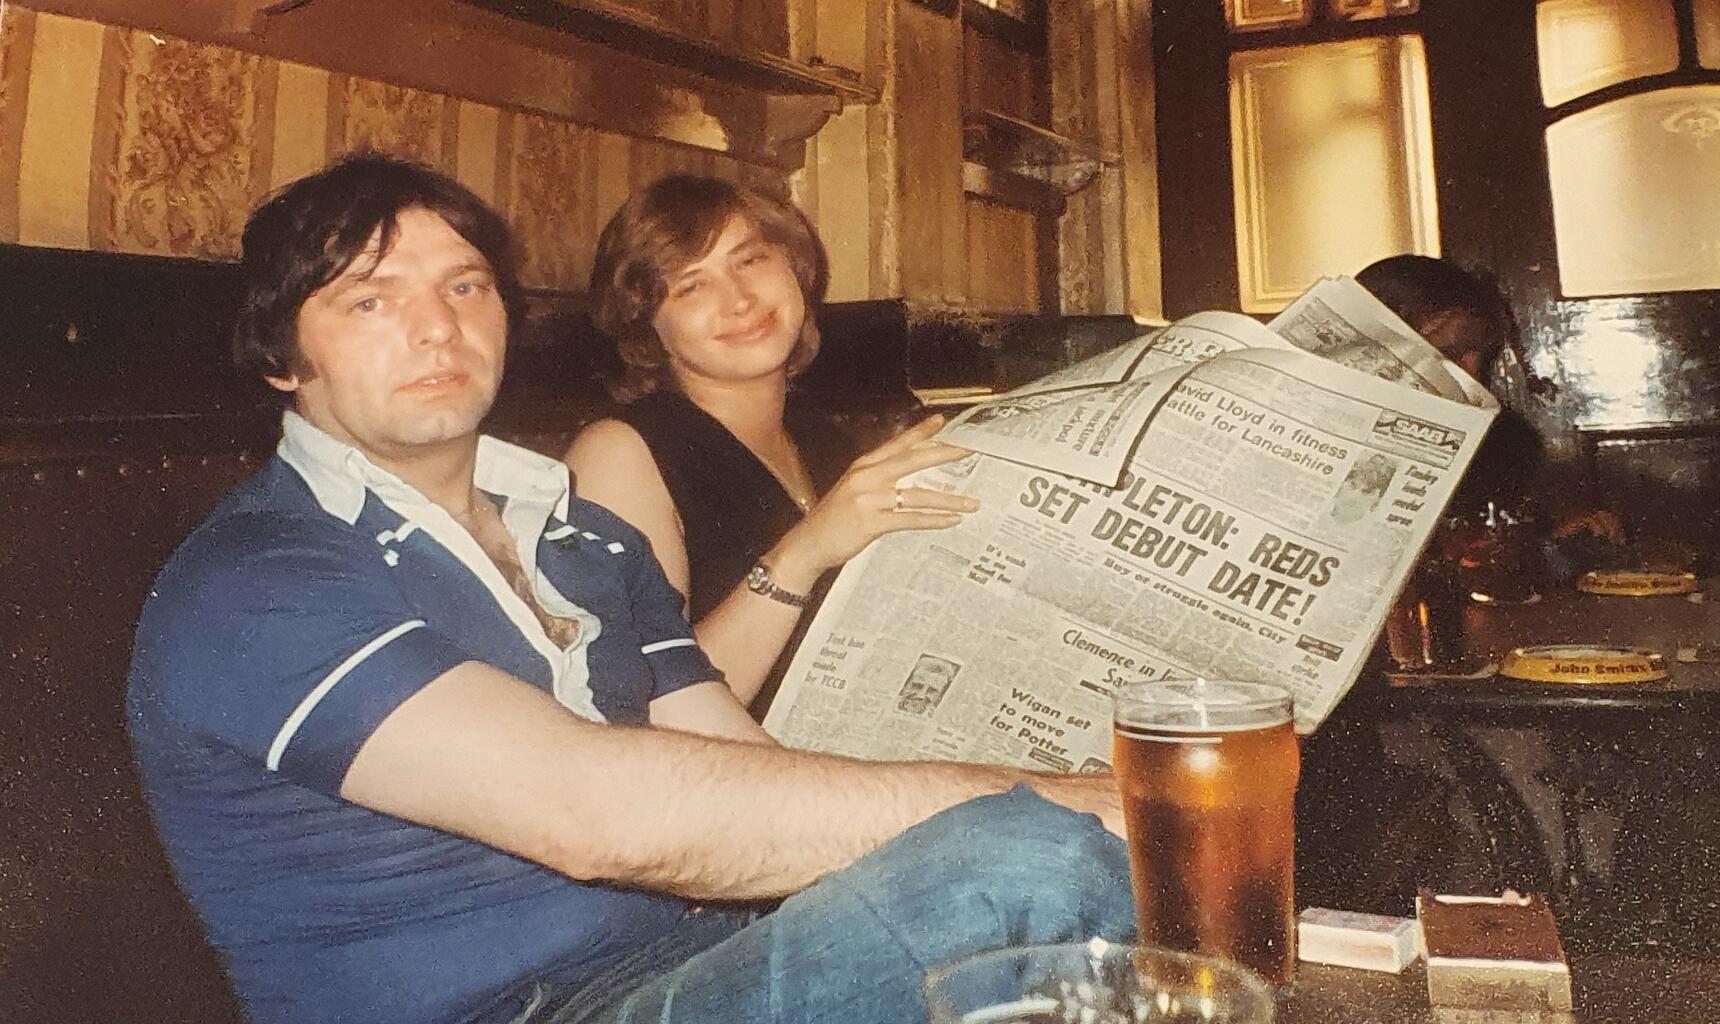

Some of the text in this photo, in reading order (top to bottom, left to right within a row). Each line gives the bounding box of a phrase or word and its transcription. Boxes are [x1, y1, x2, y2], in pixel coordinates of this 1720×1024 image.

[1167, 399, 1334, 475] attle for Lancashire
[1177, 383, 1214, 402] avid
[1217, 396, 1264, 426] Lloyd
[1269, 419, 1286, 436] in
[1291, 429, 1348, 460] fitness
[1020, 476, 1090, 524] SET
[1091, 508, 1208, 577] DEBUT
[1208, 561, 1316, 625] DATE!
[1249, 533, 1340, 587] REDS
[1153, 581, 1209, 612] struggle
[1258, 627, 1286, 644] City
[1063, 629, 1135, 669] Clemence
[1140, 664, 1155, 677] in
[989, 715, 1068, 757] for Potter
[1000, 703, 1065, 738] to move
[1011, 688, 1091, 731] Wigan set
